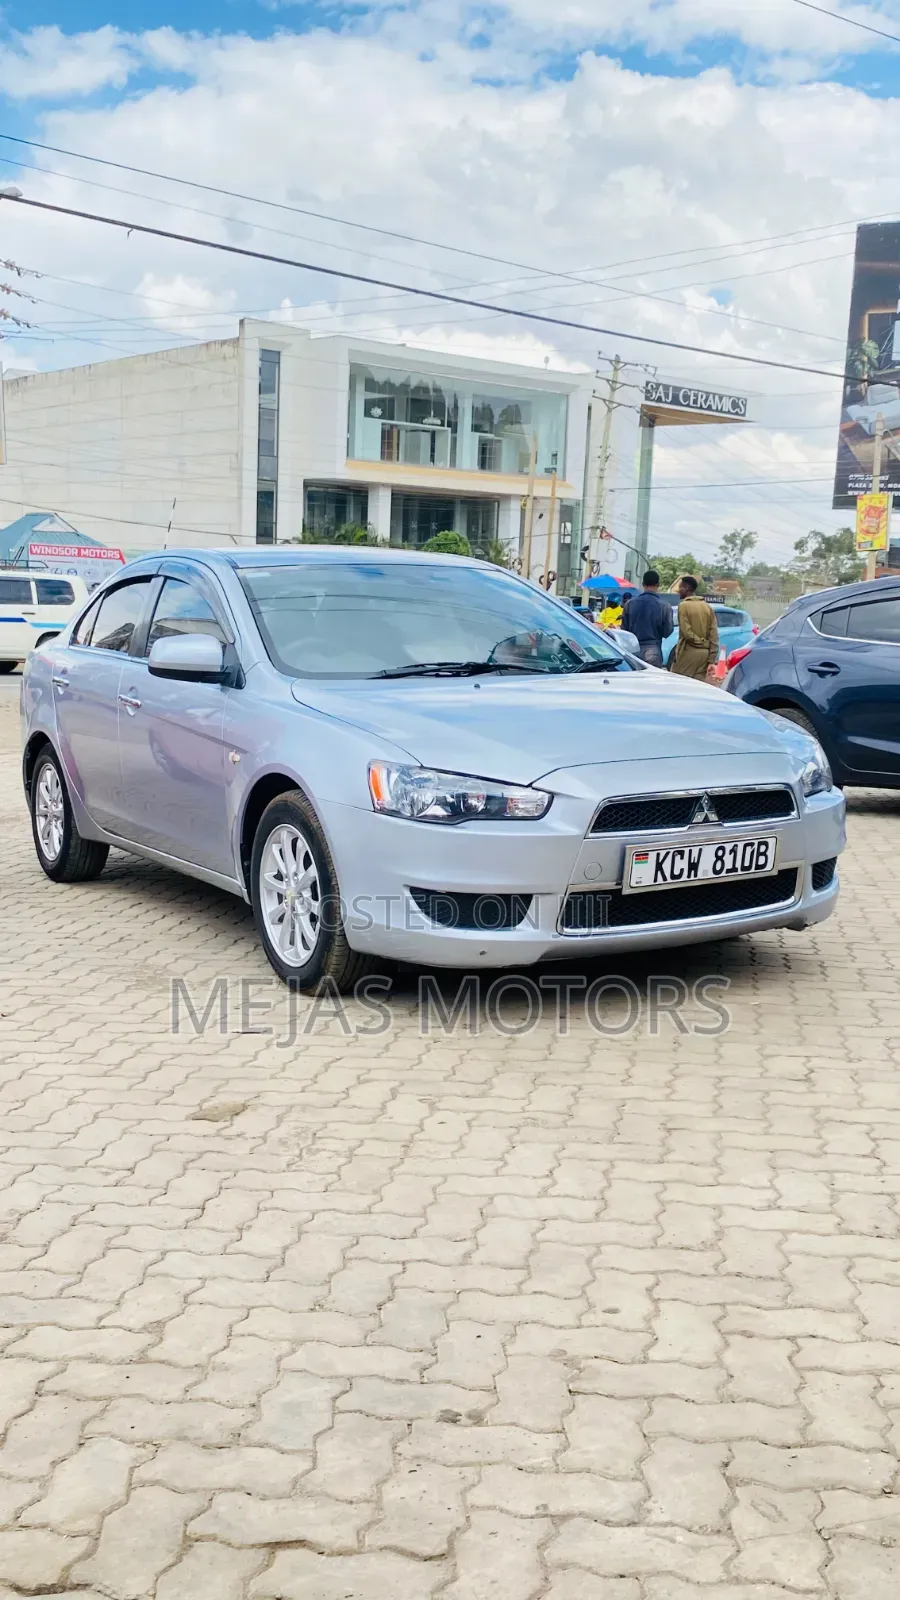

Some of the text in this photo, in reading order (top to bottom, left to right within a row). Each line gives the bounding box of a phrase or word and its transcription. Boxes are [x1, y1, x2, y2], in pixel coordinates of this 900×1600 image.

[647, 382, 746, 415] SAJ CERAMICS
[31, 545, 120, 559] WINDSOR MOTORS
[653, 840, 770, 884] KCW 810B
